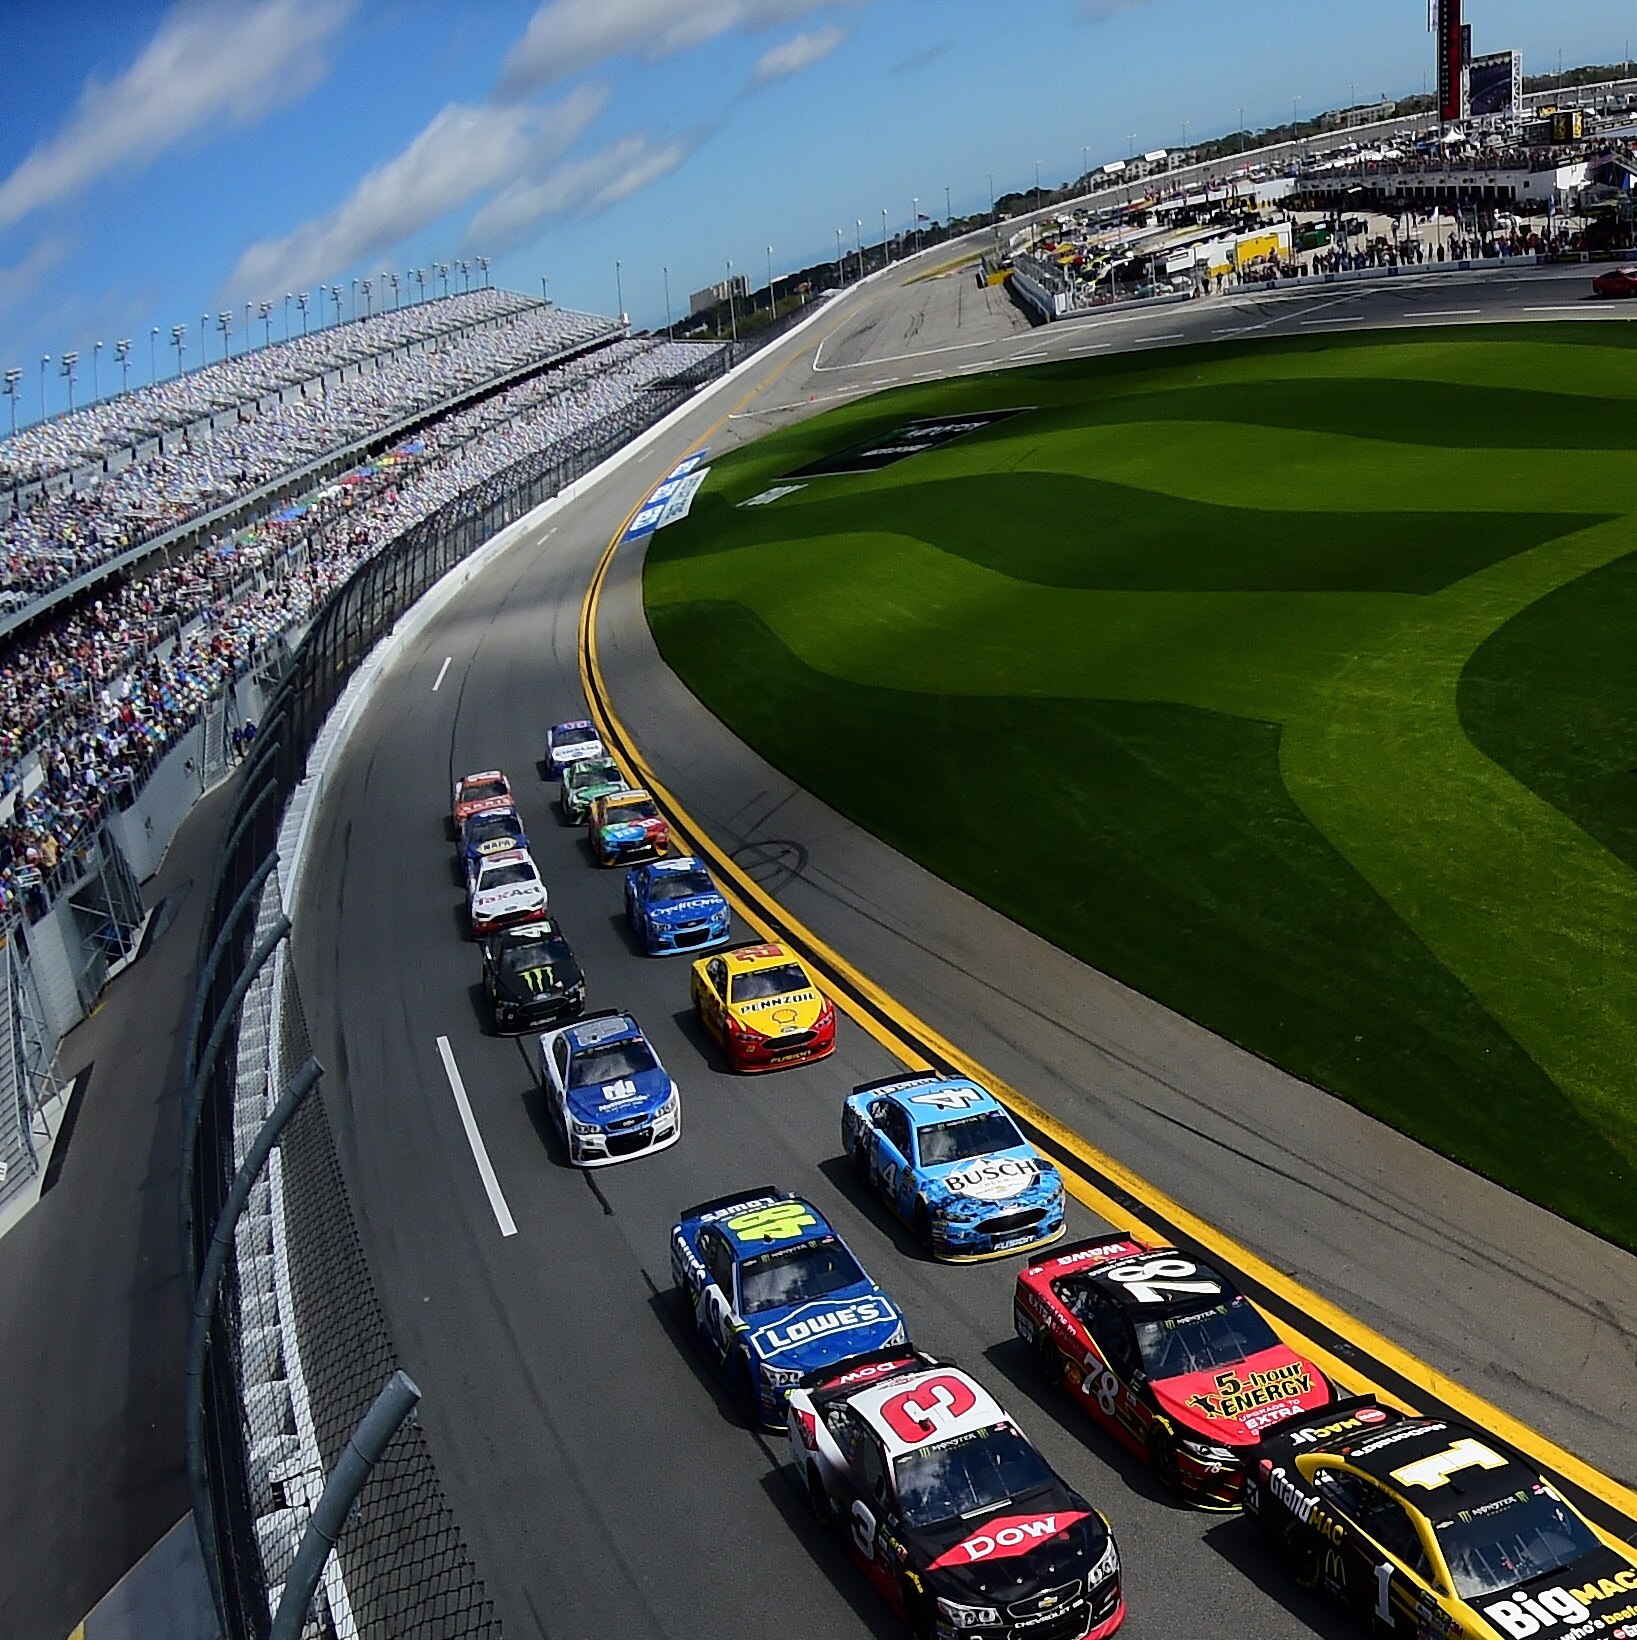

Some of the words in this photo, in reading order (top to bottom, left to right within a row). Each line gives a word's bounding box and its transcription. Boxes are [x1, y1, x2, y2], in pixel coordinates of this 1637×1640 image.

[483, 838, 512, 852] NAPA
[477, 885, 542, 906] TaxAct
[739, 992, 817, 1015] PENNZOIL
[770, 1050, 812, 1064] FUSION
[908, 1086, 985, 1110] 4
[879, 1162, 899, 1199] 4
[945, 1160, 1038, 1192] BUSCH
[727, 1203, 818, 1242] 48
[992, 1235, 1037, 1251] FUSION
[1107, 1258, 1222, 1304] 78
[765, 1302, 882, 1348] LOWE'S
[1175, 1309, 1218, 1325] MONSTER
[839, 1361, 900, 1385] DOW
[1081, 1351, 1120, 1417] 78
[1213, 1360, 1303, 1397] 5-hour
[879, 1374, 978, 1444] 3
[1220, 1374, 1312, 1418] ENERGY
[1238, 1401, 1287, 1422] UPGRADE
[1244, 1406, 1305, 1430] EXTRA
[931, 1433, 977, 1452] MONSTER
[1389, 1437, 1510, 1491] 1
[1269, 1467, 1321, 1525] Grand
[1472, 1496, 1518, 1517] MONSTER
[851, 1499, 877, 1561] 3
[960, 1516, 1057, 1562] DOW
[1373, 1561, 1396, 1629] 1
[1014, 1606, 1070, 1629] CHEVROLET
[1483, 1585, 1591, 1640] Big
